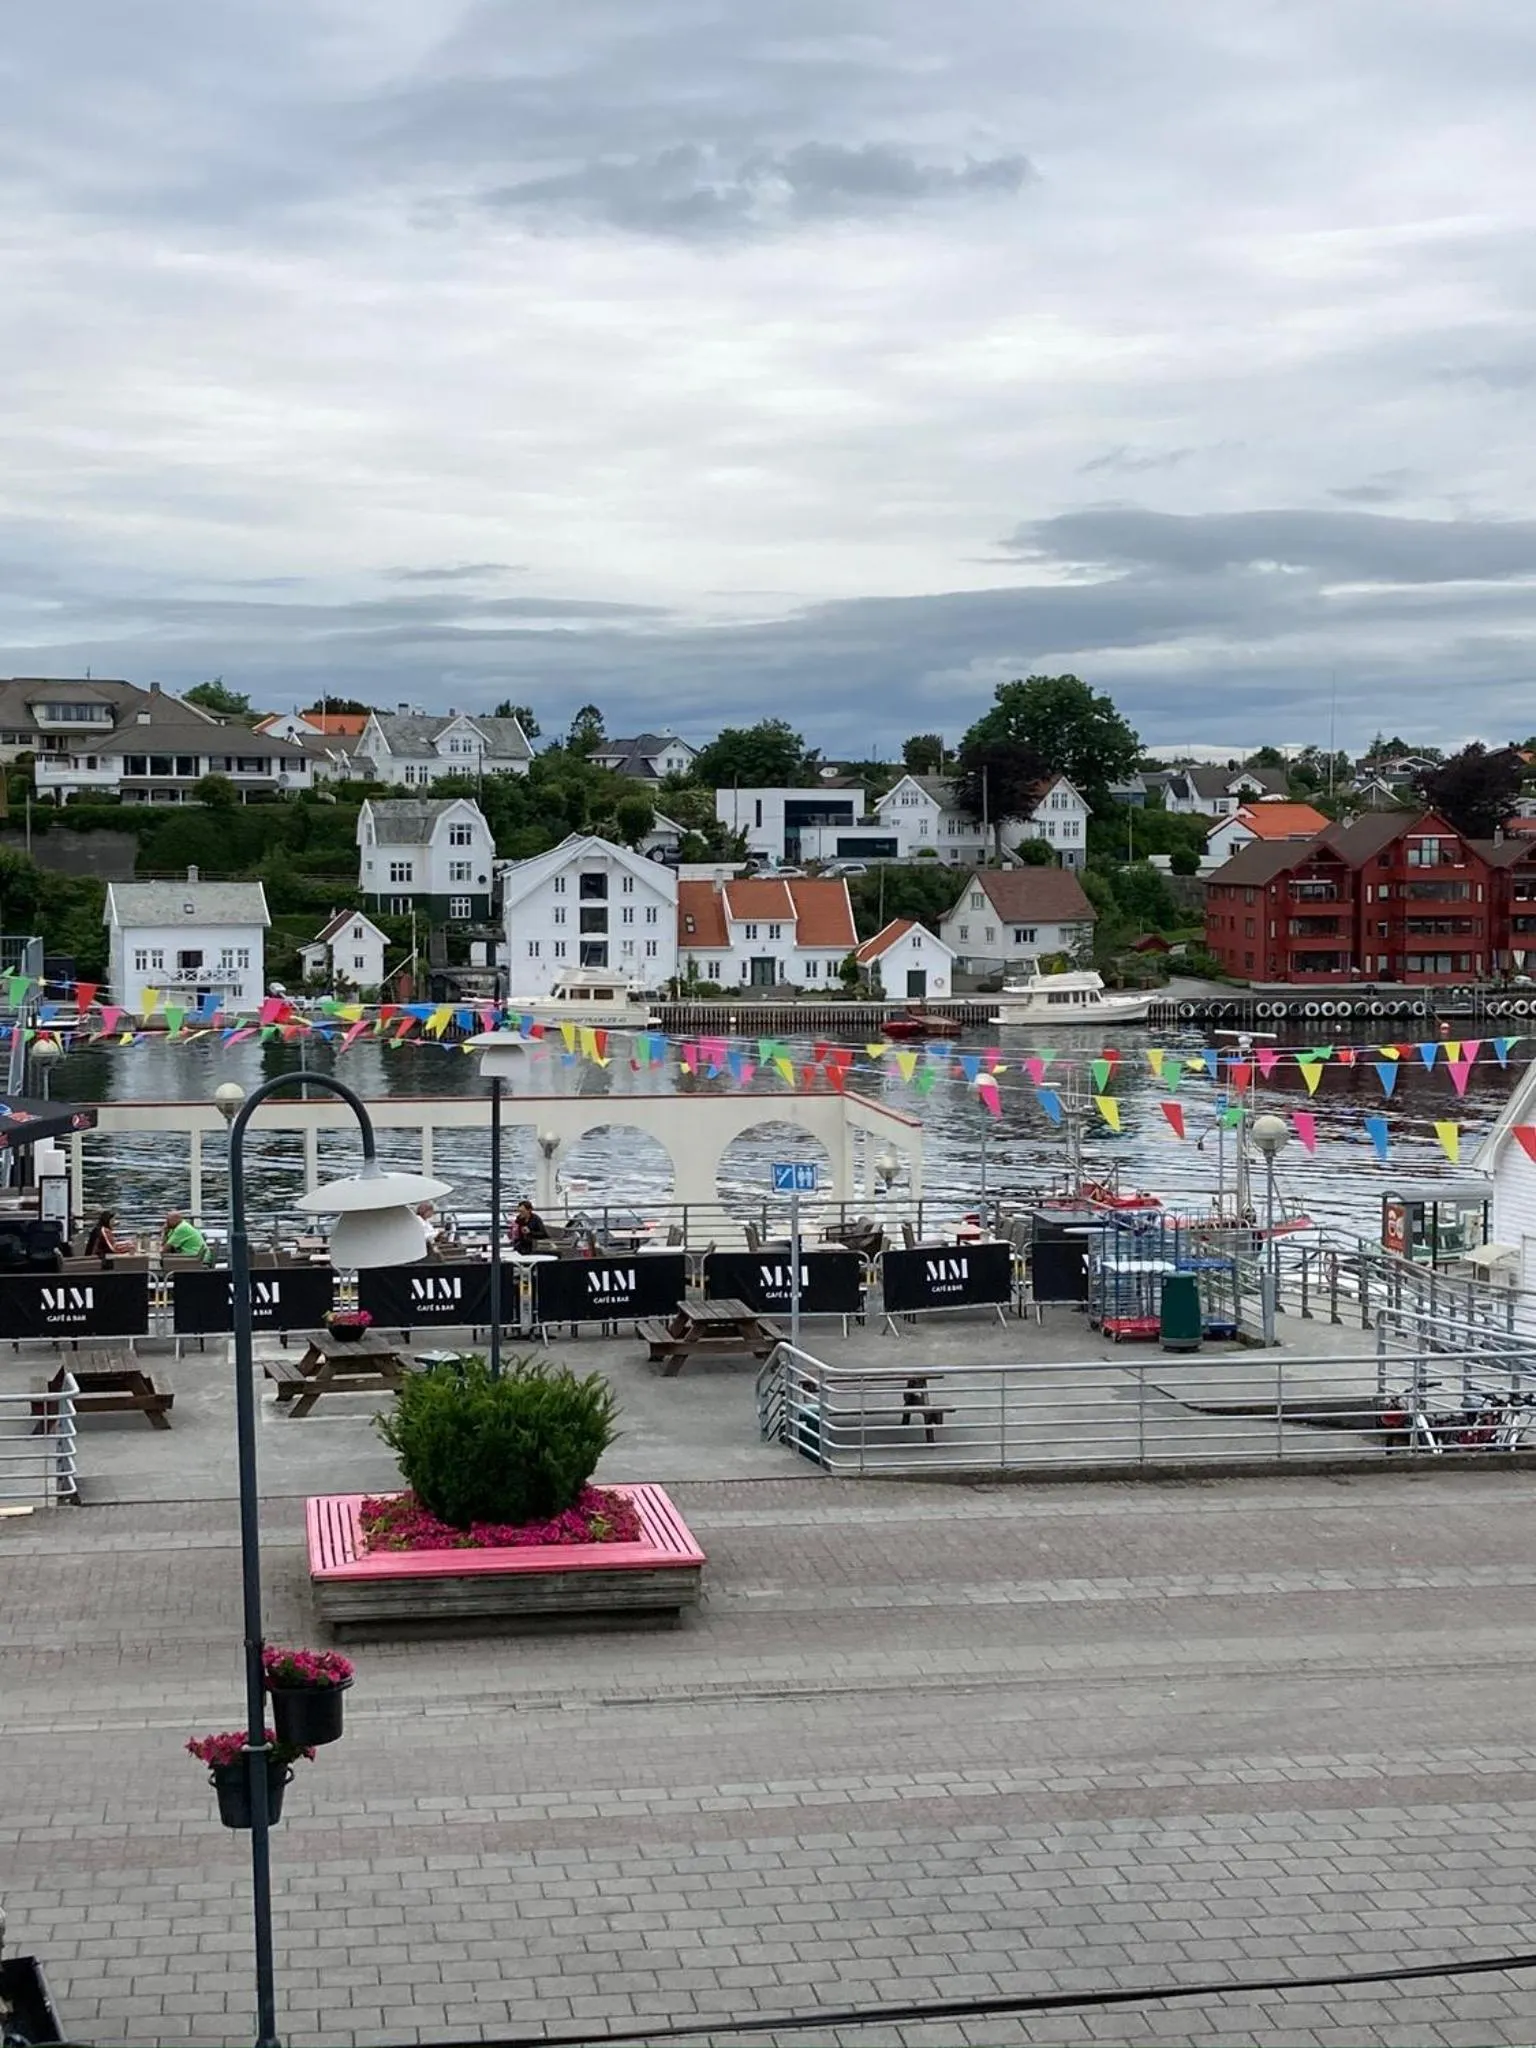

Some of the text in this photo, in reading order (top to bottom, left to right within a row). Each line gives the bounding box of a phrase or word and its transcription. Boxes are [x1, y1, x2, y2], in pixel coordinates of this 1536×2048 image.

[588, 1269, 636, 1292] MM
[926, 1258, 969, 1281] MM
[41, 1287, 94, 1310] MM
[411, 1277, 461, 1300] MM
